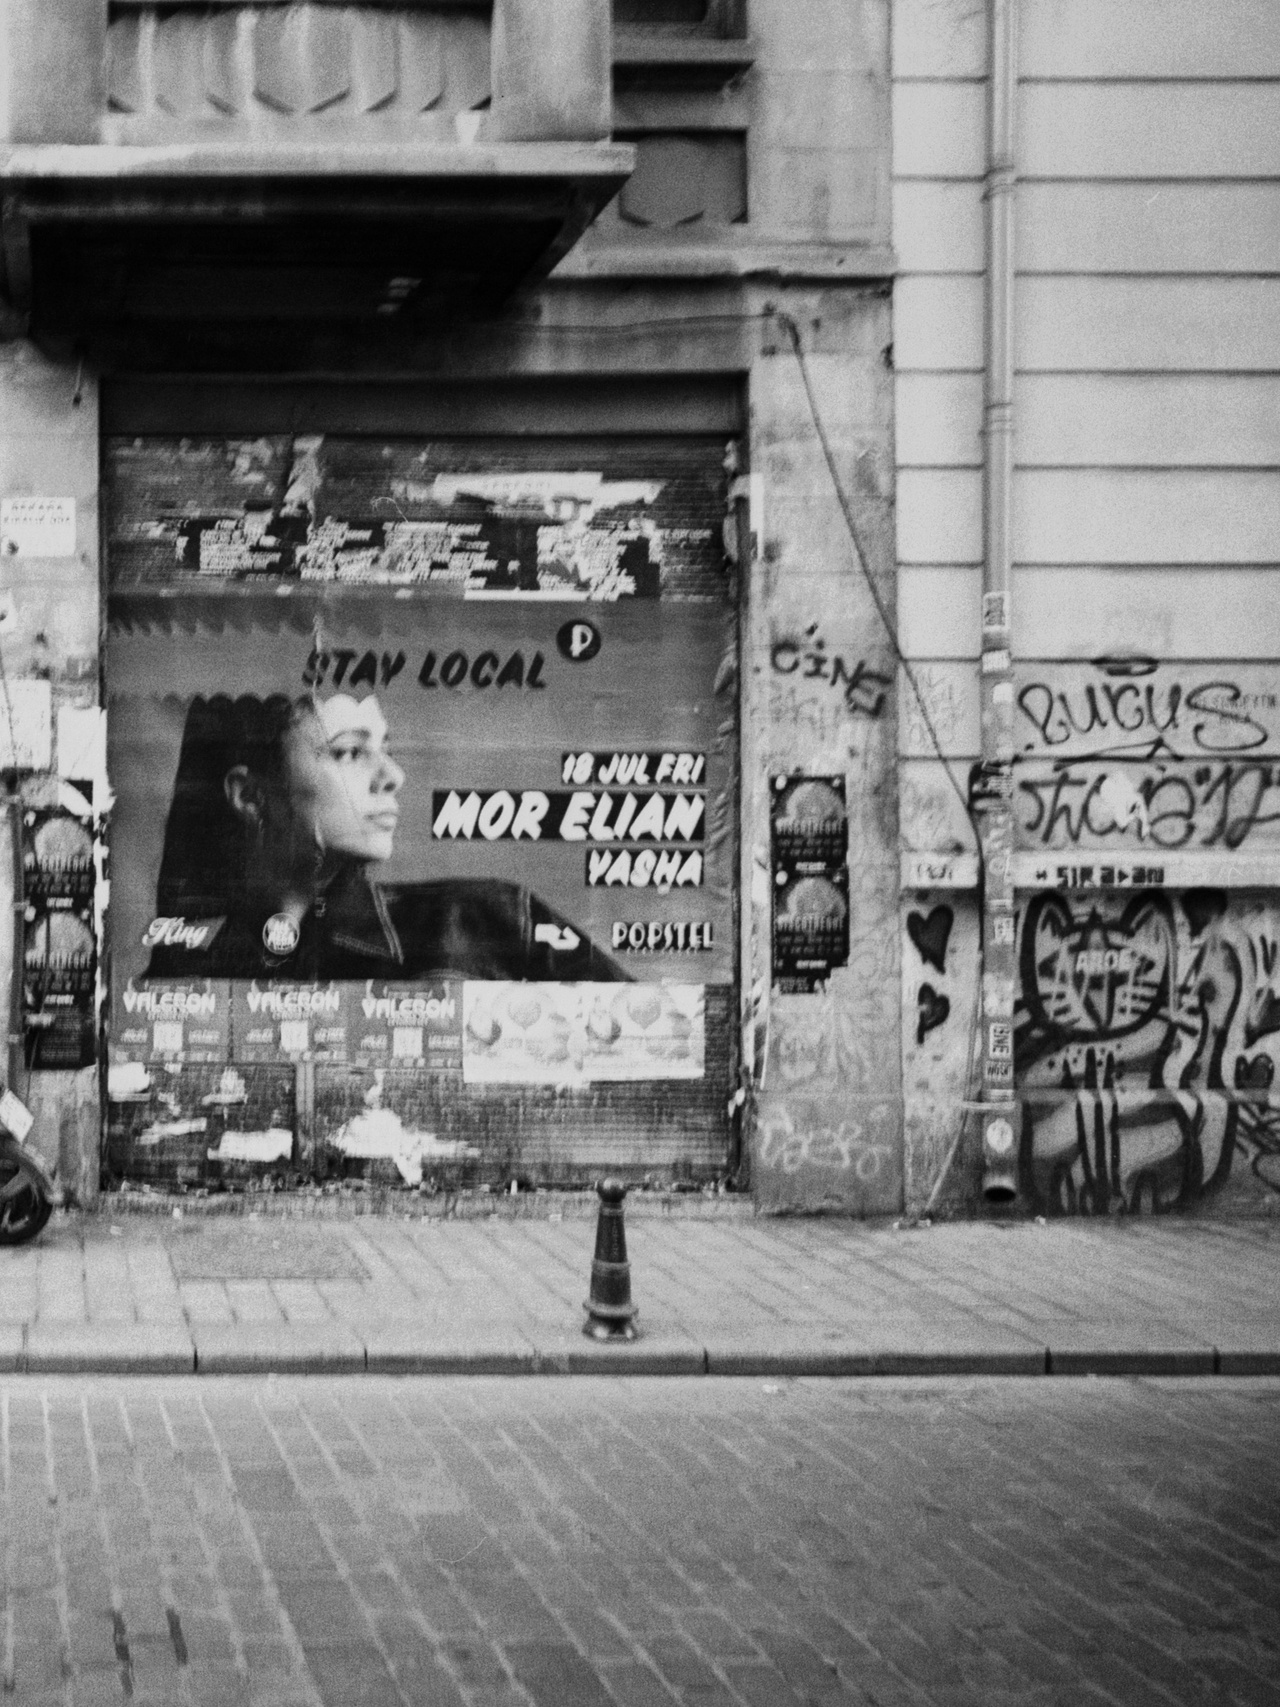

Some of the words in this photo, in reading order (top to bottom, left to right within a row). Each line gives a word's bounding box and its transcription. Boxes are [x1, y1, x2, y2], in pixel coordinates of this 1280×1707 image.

[301, 649, 407, 690] STAY
[417, 649, 548, 690] LOCAL
[562, 752, 595, 785] 18
[598, 752, 651, 785] JUL
[655, 753, 706, 785] FRI
[432, 789, 550, 841] MOR
[559, 790, 706, 842] ELIAN
[588, 849, 702, 888] YASHA
[142, 916, 211, 949] King
[612, 921, 714, 949] POPSTEL
